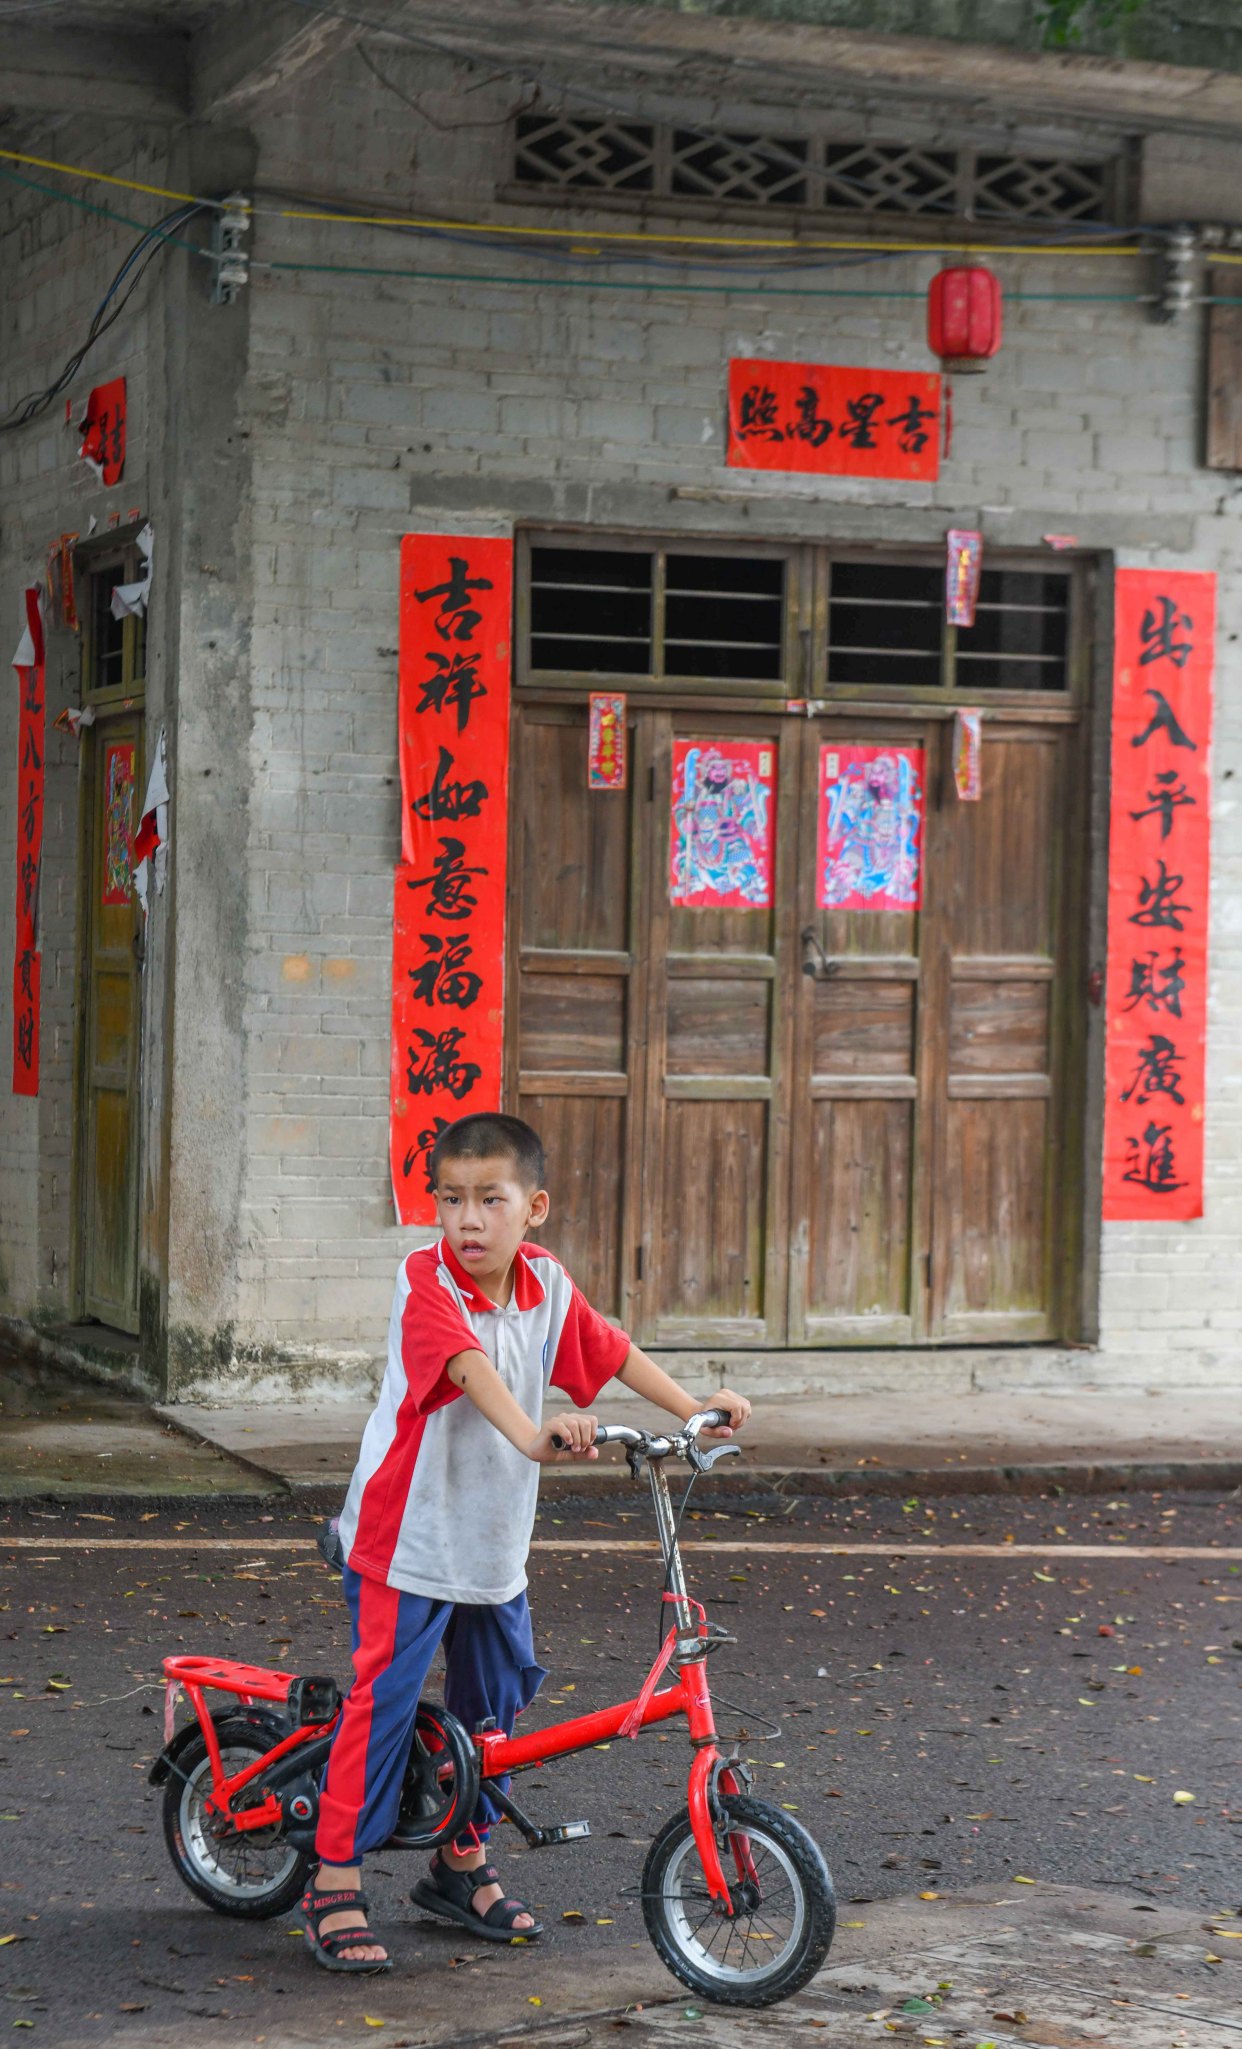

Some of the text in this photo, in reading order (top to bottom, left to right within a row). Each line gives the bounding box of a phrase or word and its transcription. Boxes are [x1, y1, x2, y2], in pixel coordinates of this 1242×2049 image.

[1119, 595, 1198, 1193] 出入平安財廣進
